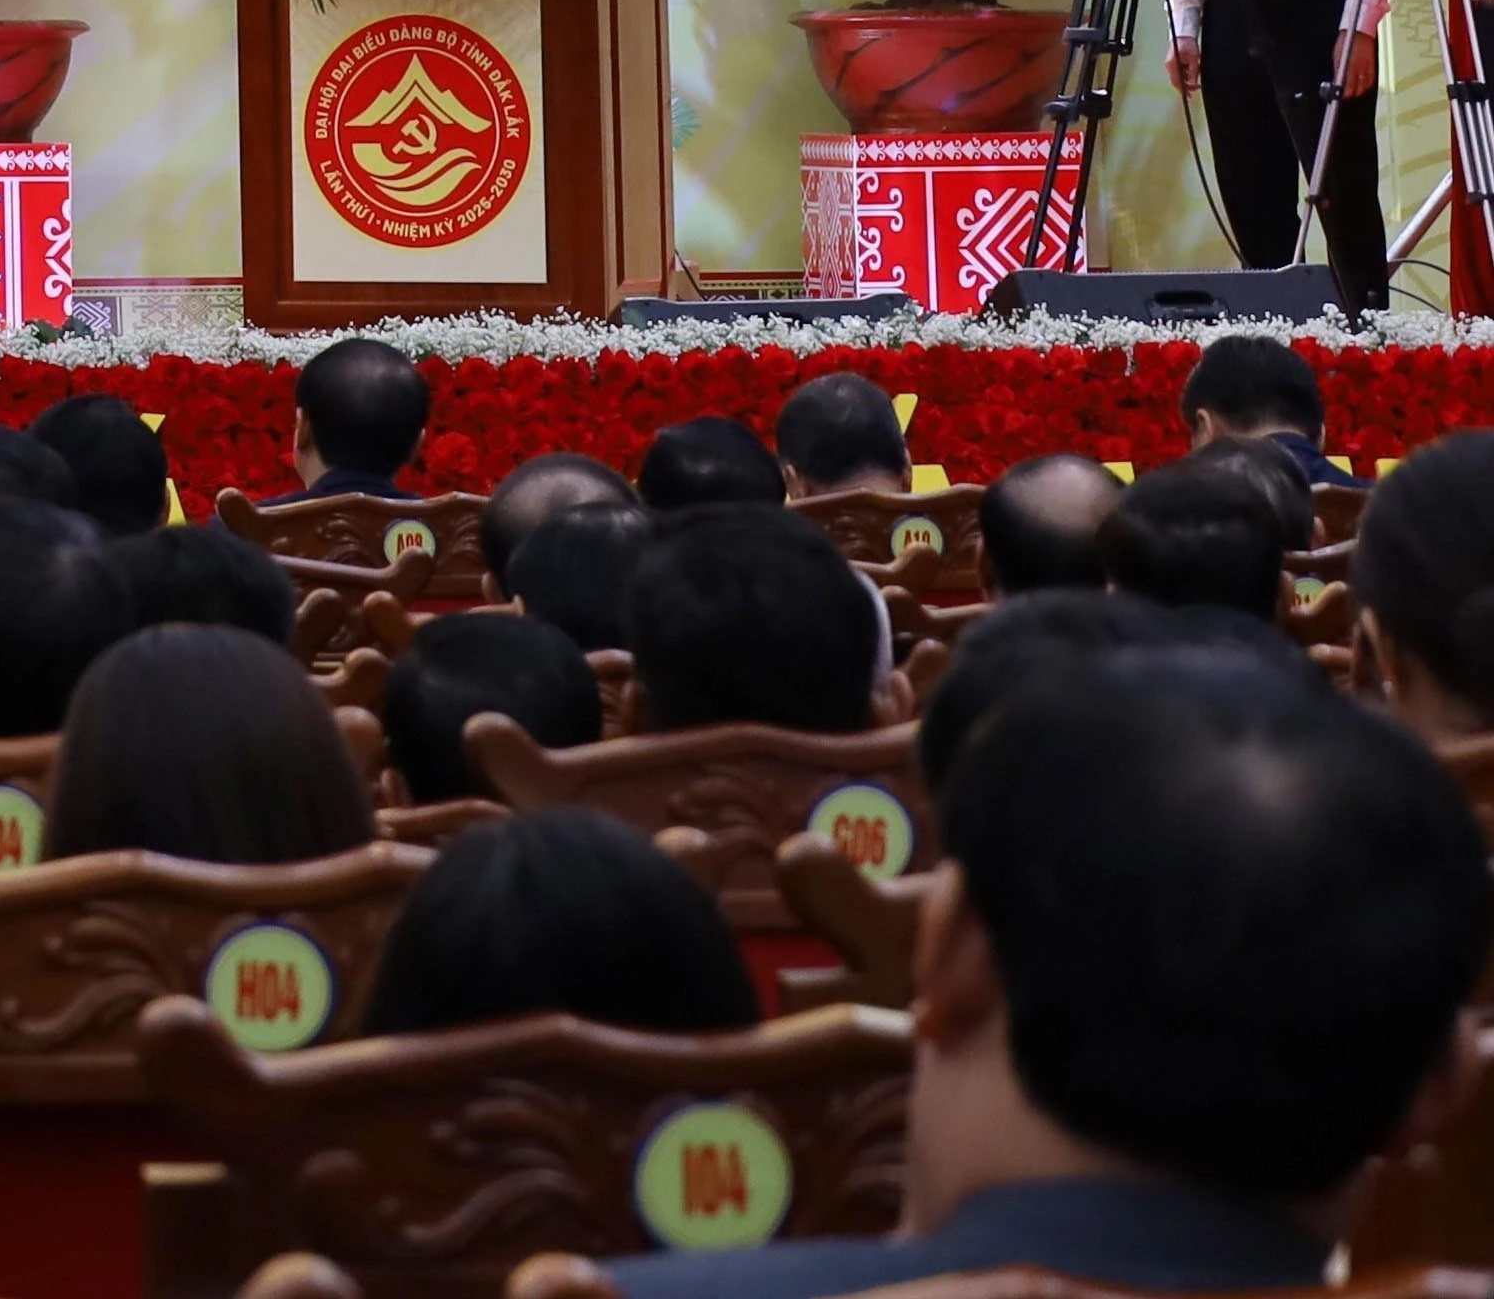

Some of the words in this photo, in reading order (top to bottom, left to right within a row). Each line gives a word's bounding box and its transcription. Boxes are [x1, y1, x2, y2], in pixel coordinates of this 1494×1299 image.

[353, 32, 387, 60] BIỂU
[389, 23, 433, 42] ĐẢNG
[436, 29, 457, 50] BỘ
[331, 54, 355, 82] ĐẠI
[461, 39, 491, 72] TỈNH
[318, 81, 338, 110] HỘI
[315, 113, 331, 139] ĐẠI
[503, 104, 520, 138] LẮK
[341, 187, 369, 219] THỨ
[367, 213, 374, 225] I
[382, 219, 431, 240] NHIỆM
[434, 217, 455, 237] KỲ
[457, 159, 517, 229] 2025-2030
[237, 959, 299, 1023] H04
[682, 1143, 746, 1214] I04
